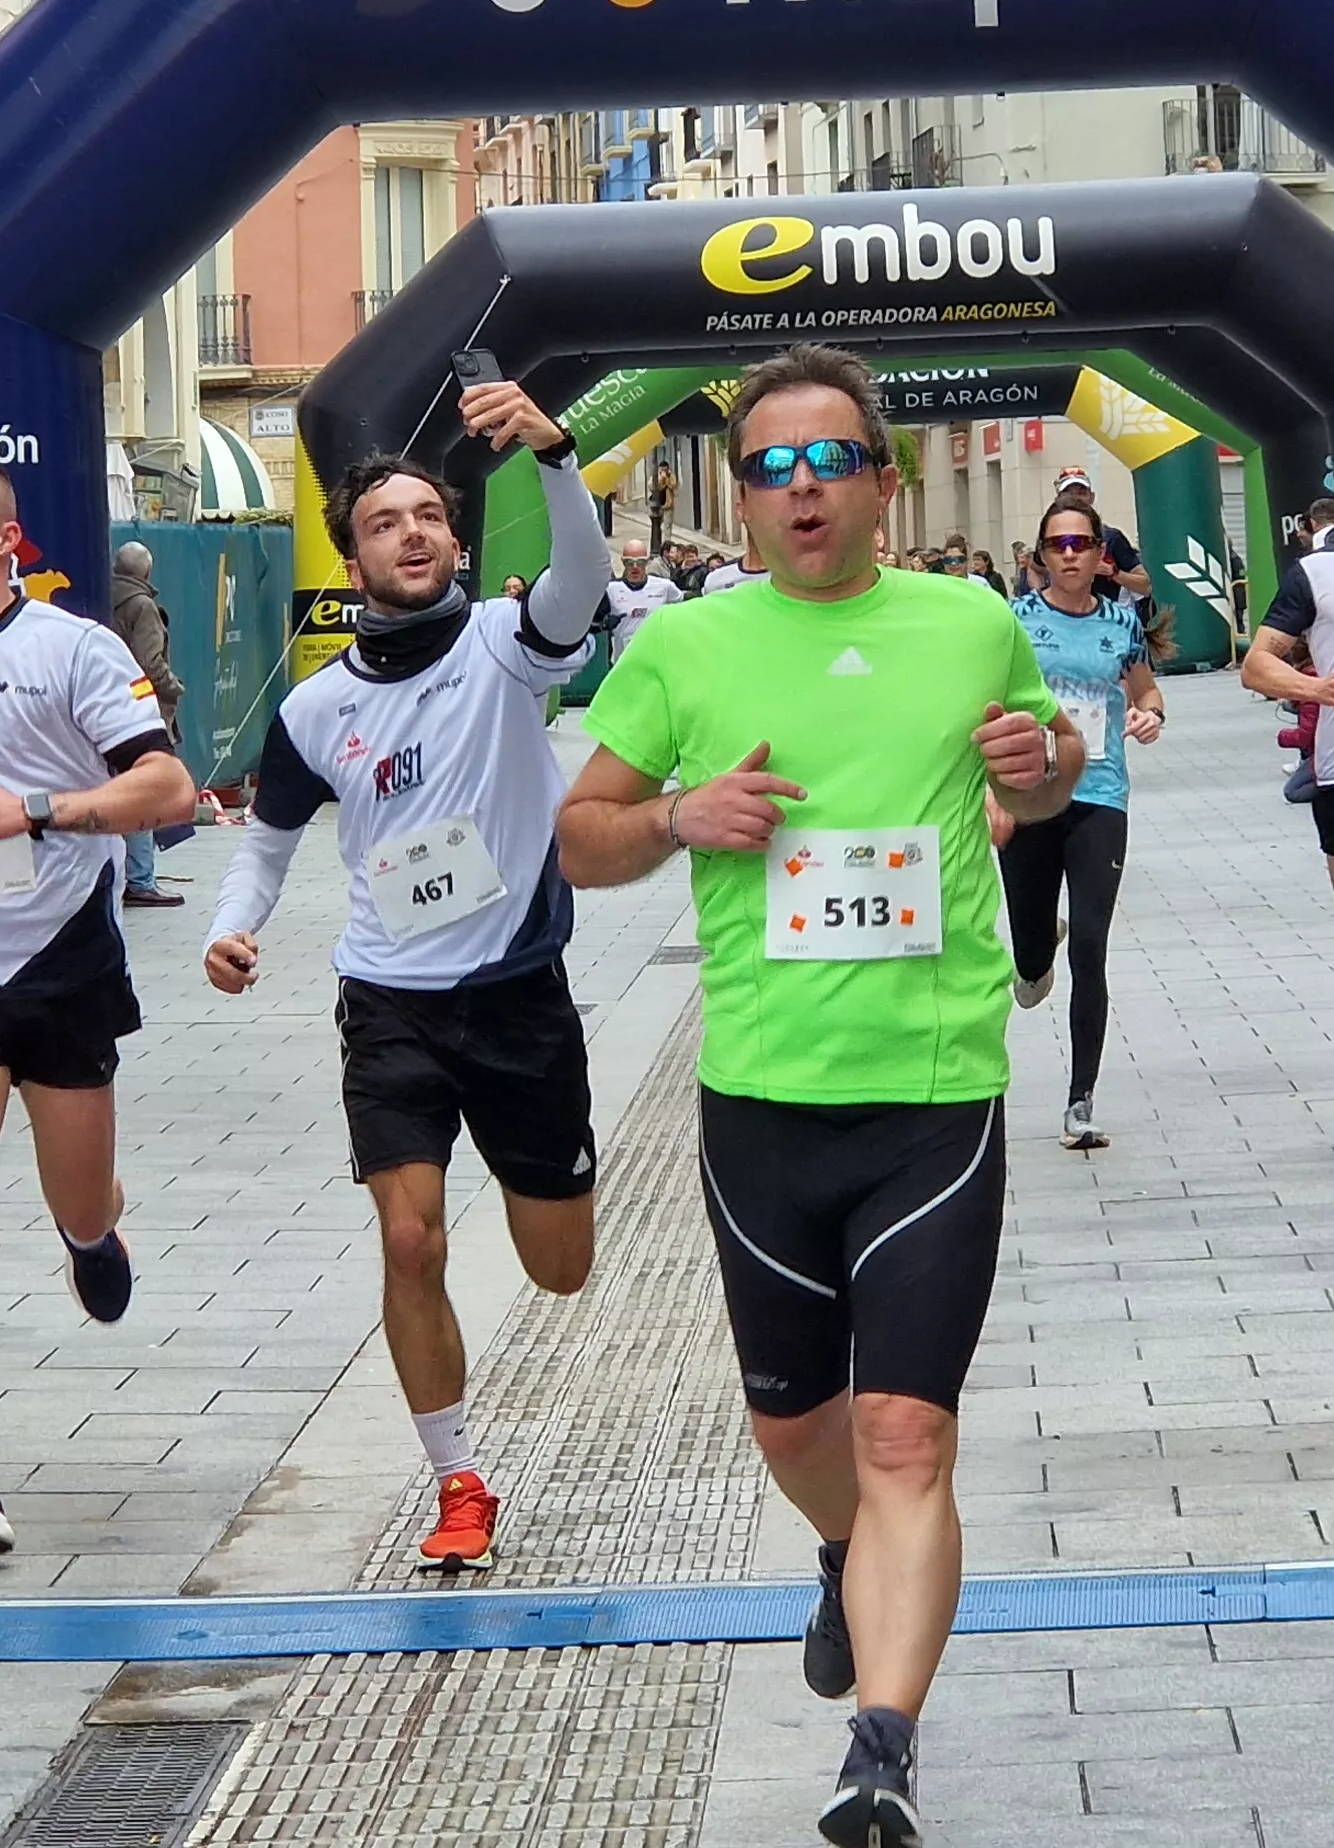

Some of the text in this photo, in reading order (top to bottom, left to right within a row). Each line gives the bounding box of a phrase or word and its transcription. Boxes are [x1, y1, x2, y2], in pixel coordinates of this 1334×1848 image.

[700, 202, 1056, 294] embou
[706, 301, 1056, 331] PÁSATE A LA OPERADORA ARAGONESA
[905, 391, 934, 408] DE
[942, 383, 1039, 406] ARAGÓN
[257, 424, 290, 432] ALTO
[411, 871, 454, 906] 467
[823, 896, 891, 928] 513
